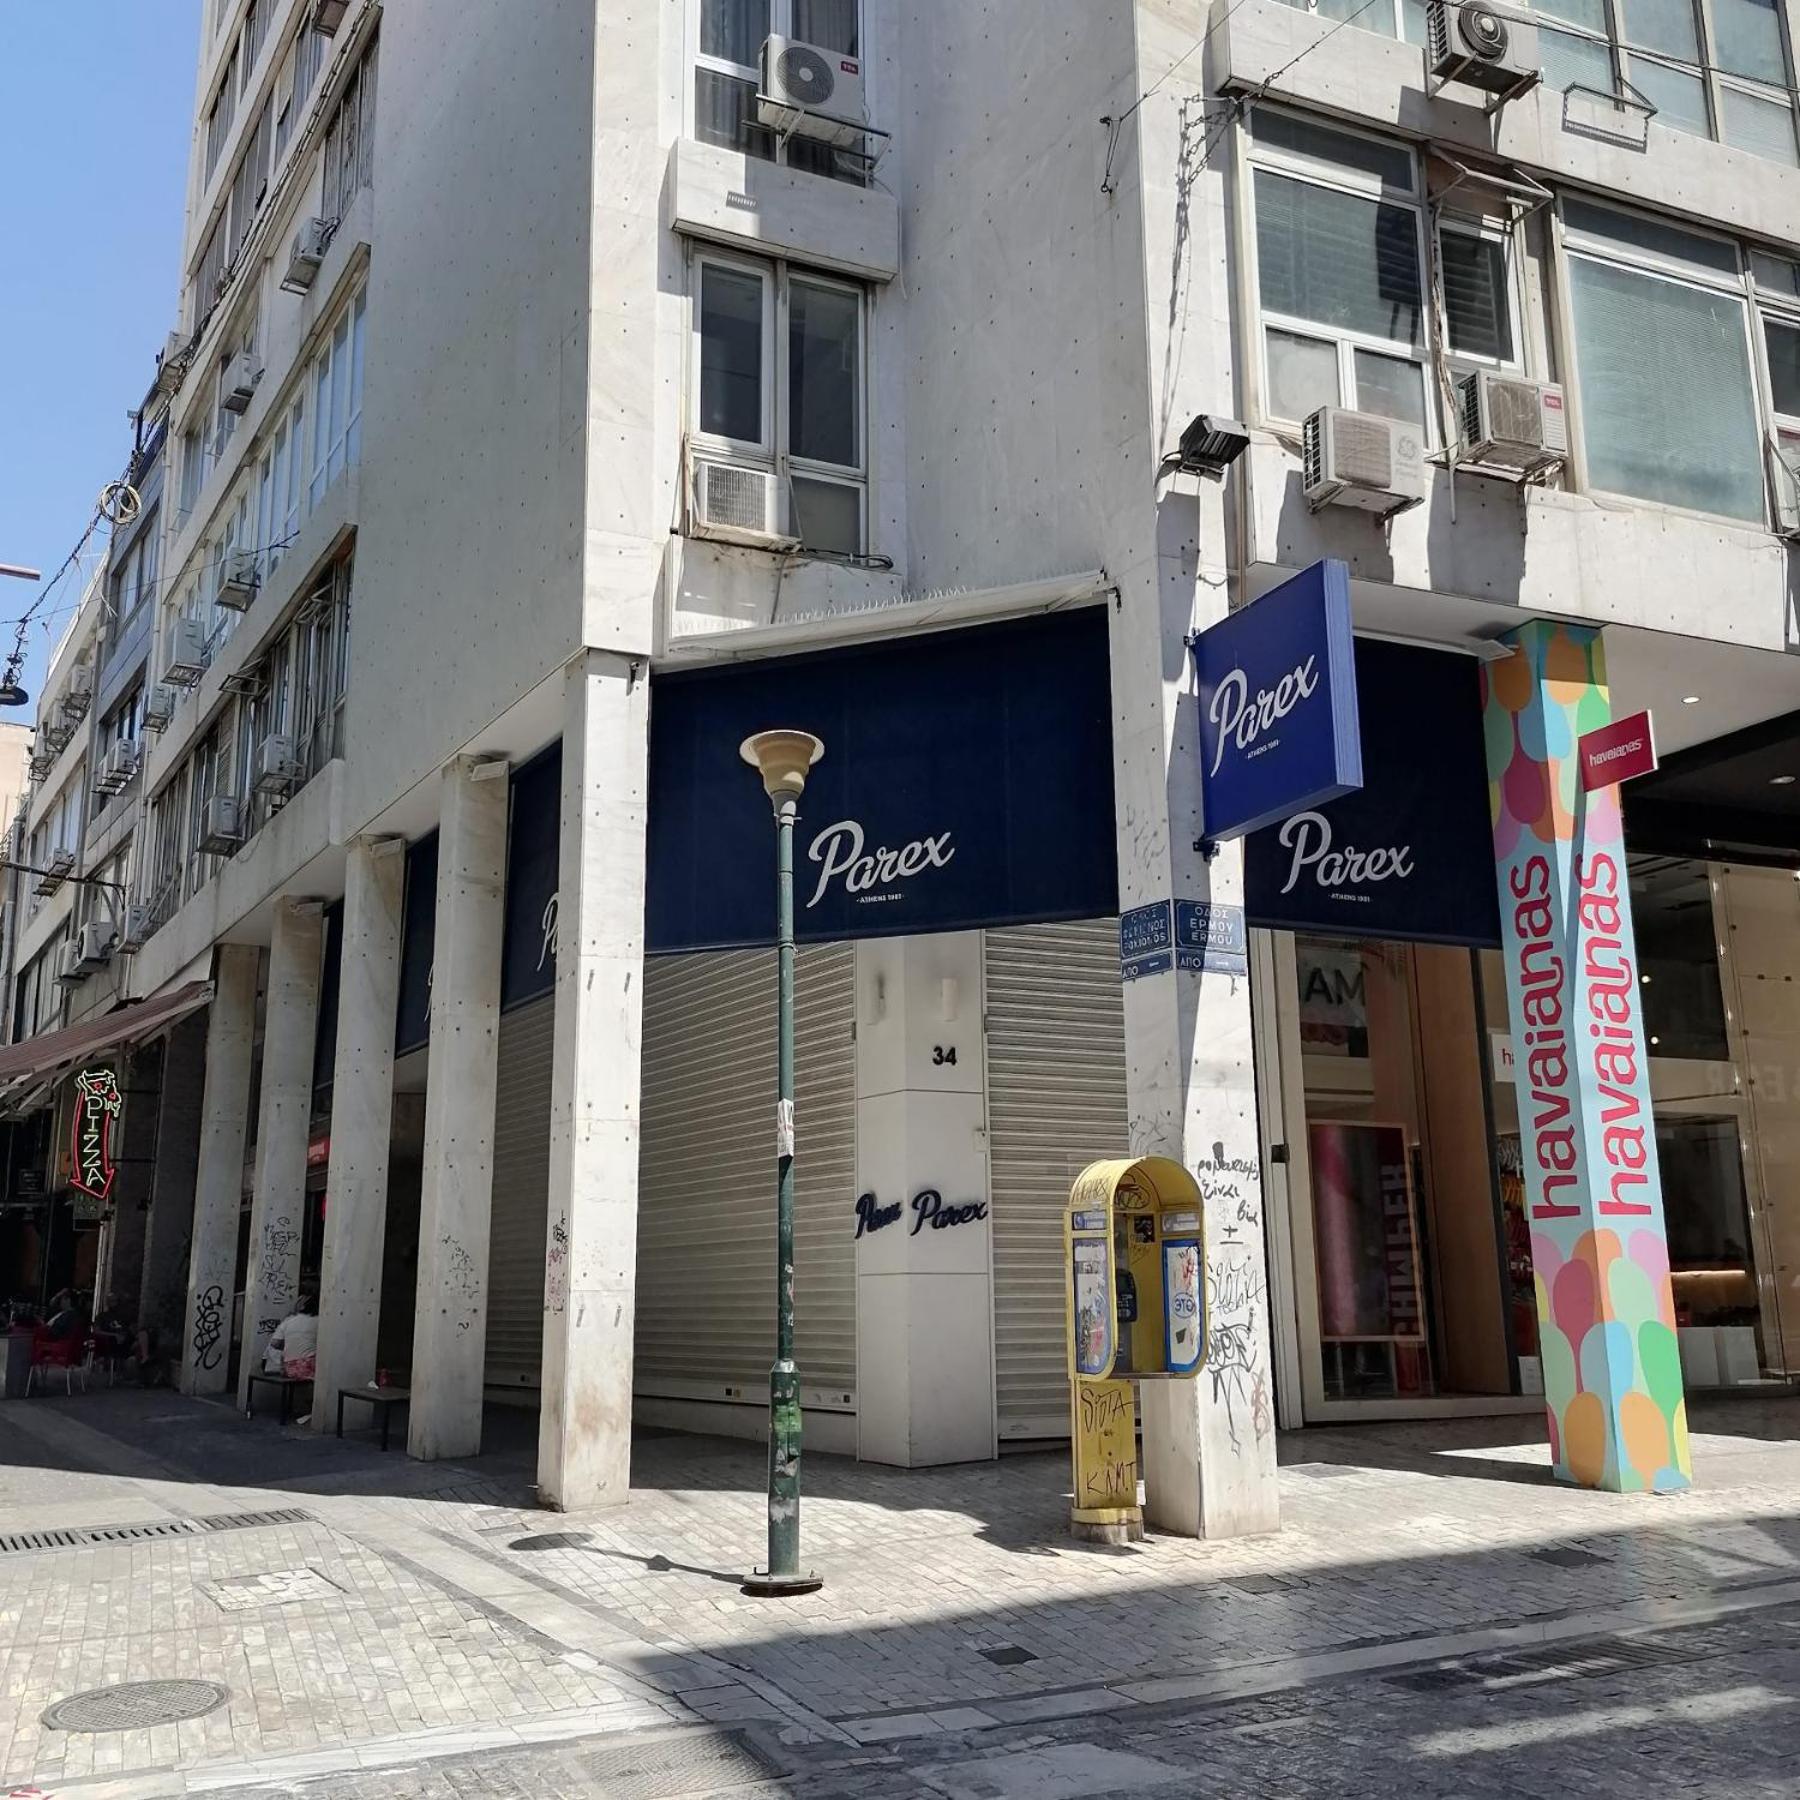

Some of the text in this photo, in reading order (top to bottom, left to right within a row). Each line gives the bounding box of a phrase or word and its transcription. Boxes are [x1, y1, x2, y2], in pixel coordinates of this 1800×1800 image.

[1209, 654, 1319, 778] Parex
[1589, 738, 1643, 768] havaianas
[806, 820, 955, 908] Parex
[1279, 811, 1414, 894] Parex
[1189, 918, 1234, 933] ΕΡΜΟΥ
[1191, 932, 1233, 946] ERMOU
[1194, 906, 1229, 919] ΟΔΟΣ
[932, 1046, 957, 1066] 34
[1510, 855, 1581, 1219] havaianas
[1574, 852, 1652, 1215] havaianas
[82, 1096, 106, 1187] PIZZA
[910, 1189, 988, 1237] Parex
